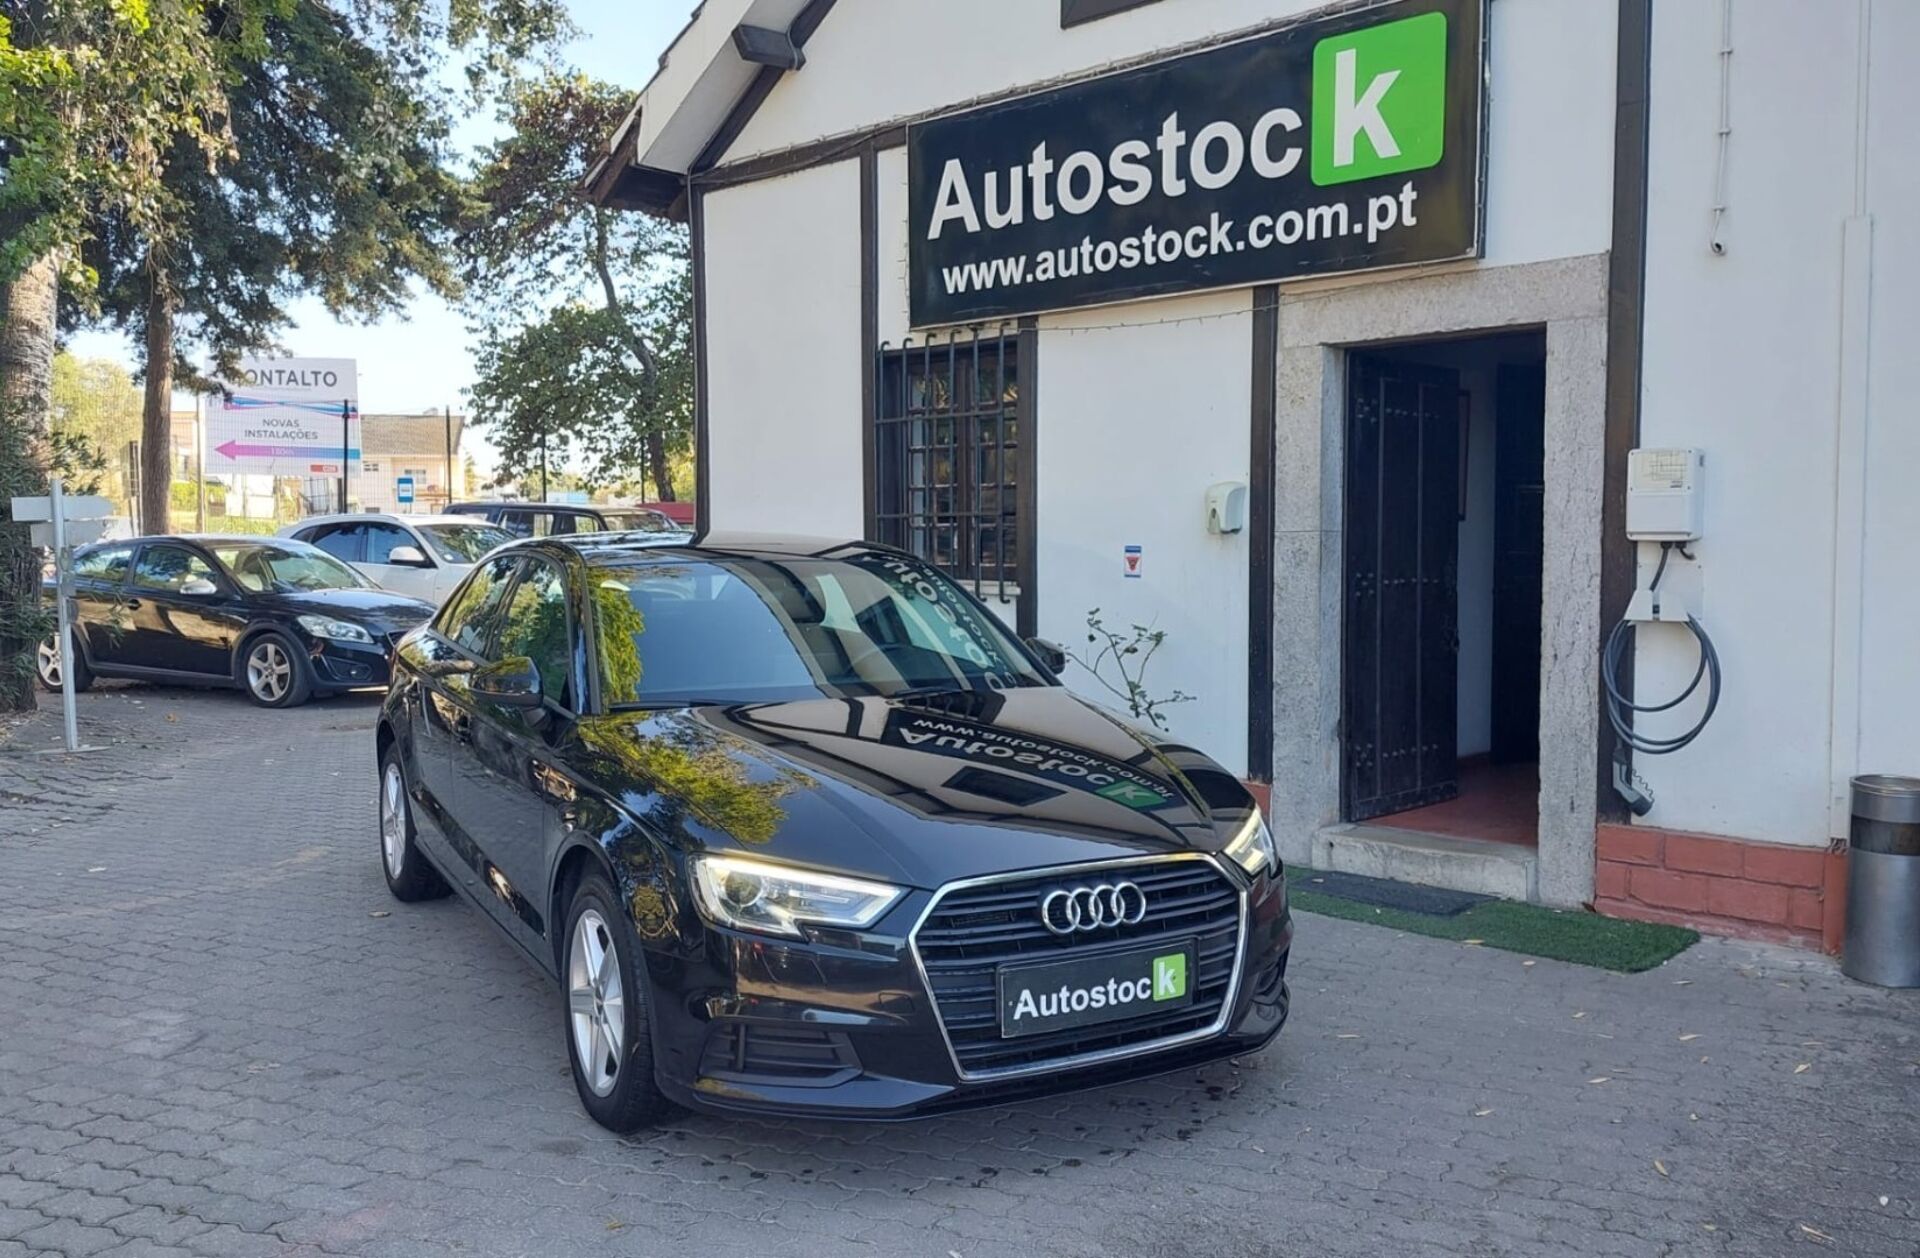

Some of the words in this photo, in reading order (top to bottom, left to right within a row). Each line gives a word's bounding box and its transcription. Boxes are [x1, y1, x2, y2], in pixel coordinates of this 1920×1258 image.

[927, 48, 1402, 241] Autostock
[941, 180, 1418, 295] www.autostock.com.pt
[243, 369, 337, 387] ONTALTO
[244, 428, 318, 440] INSTALAÇÕES
[262, 418, 300, 428] NOVAS
[1013, 961, 1176, 1020] Autostock
